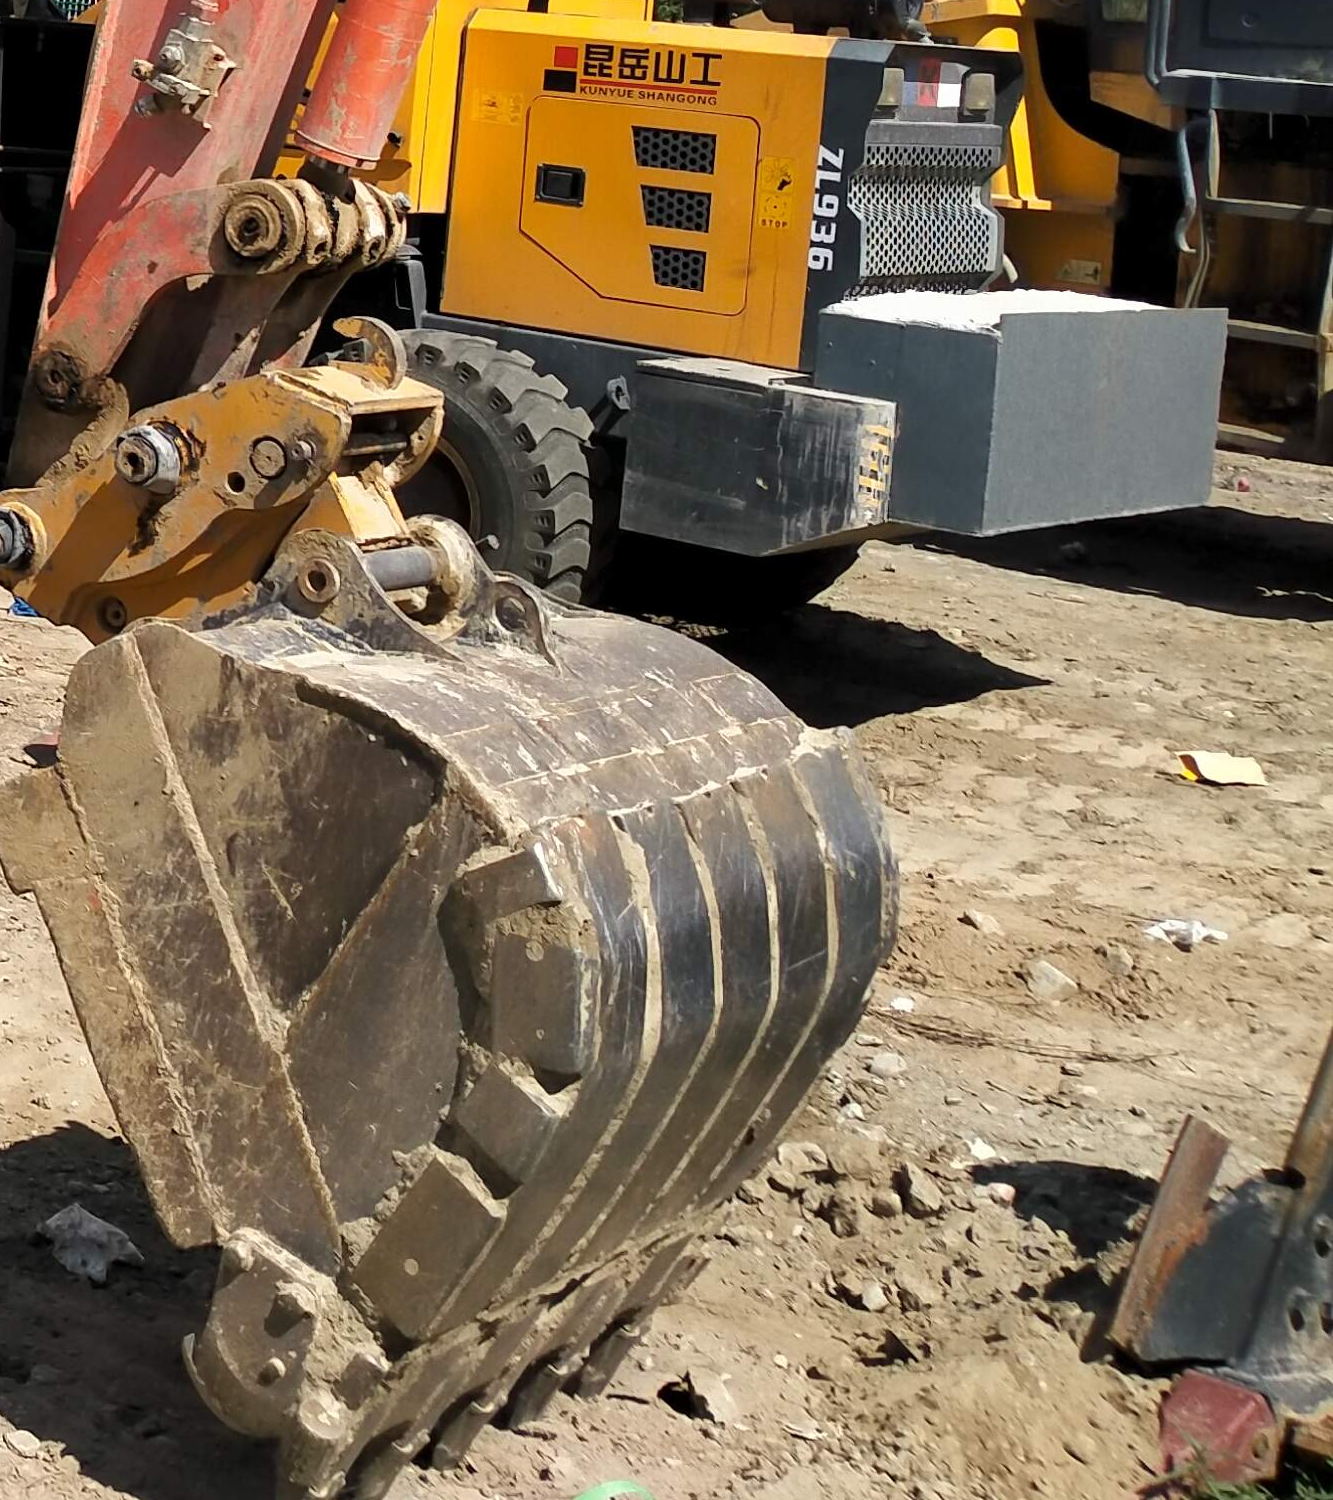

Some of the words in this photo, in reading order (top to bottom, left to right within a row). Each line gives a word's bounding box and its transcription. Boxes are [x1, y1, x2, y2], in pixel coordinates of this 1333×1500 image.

[582, 43, 723, 87] 昆岳山工
[579, 85, 634, 99] KUNYUE
[637, 90, 718, 106] SHANGONG
[761, 218, 788, 229] STOP
[807, 144, 845, 271] ZL936
